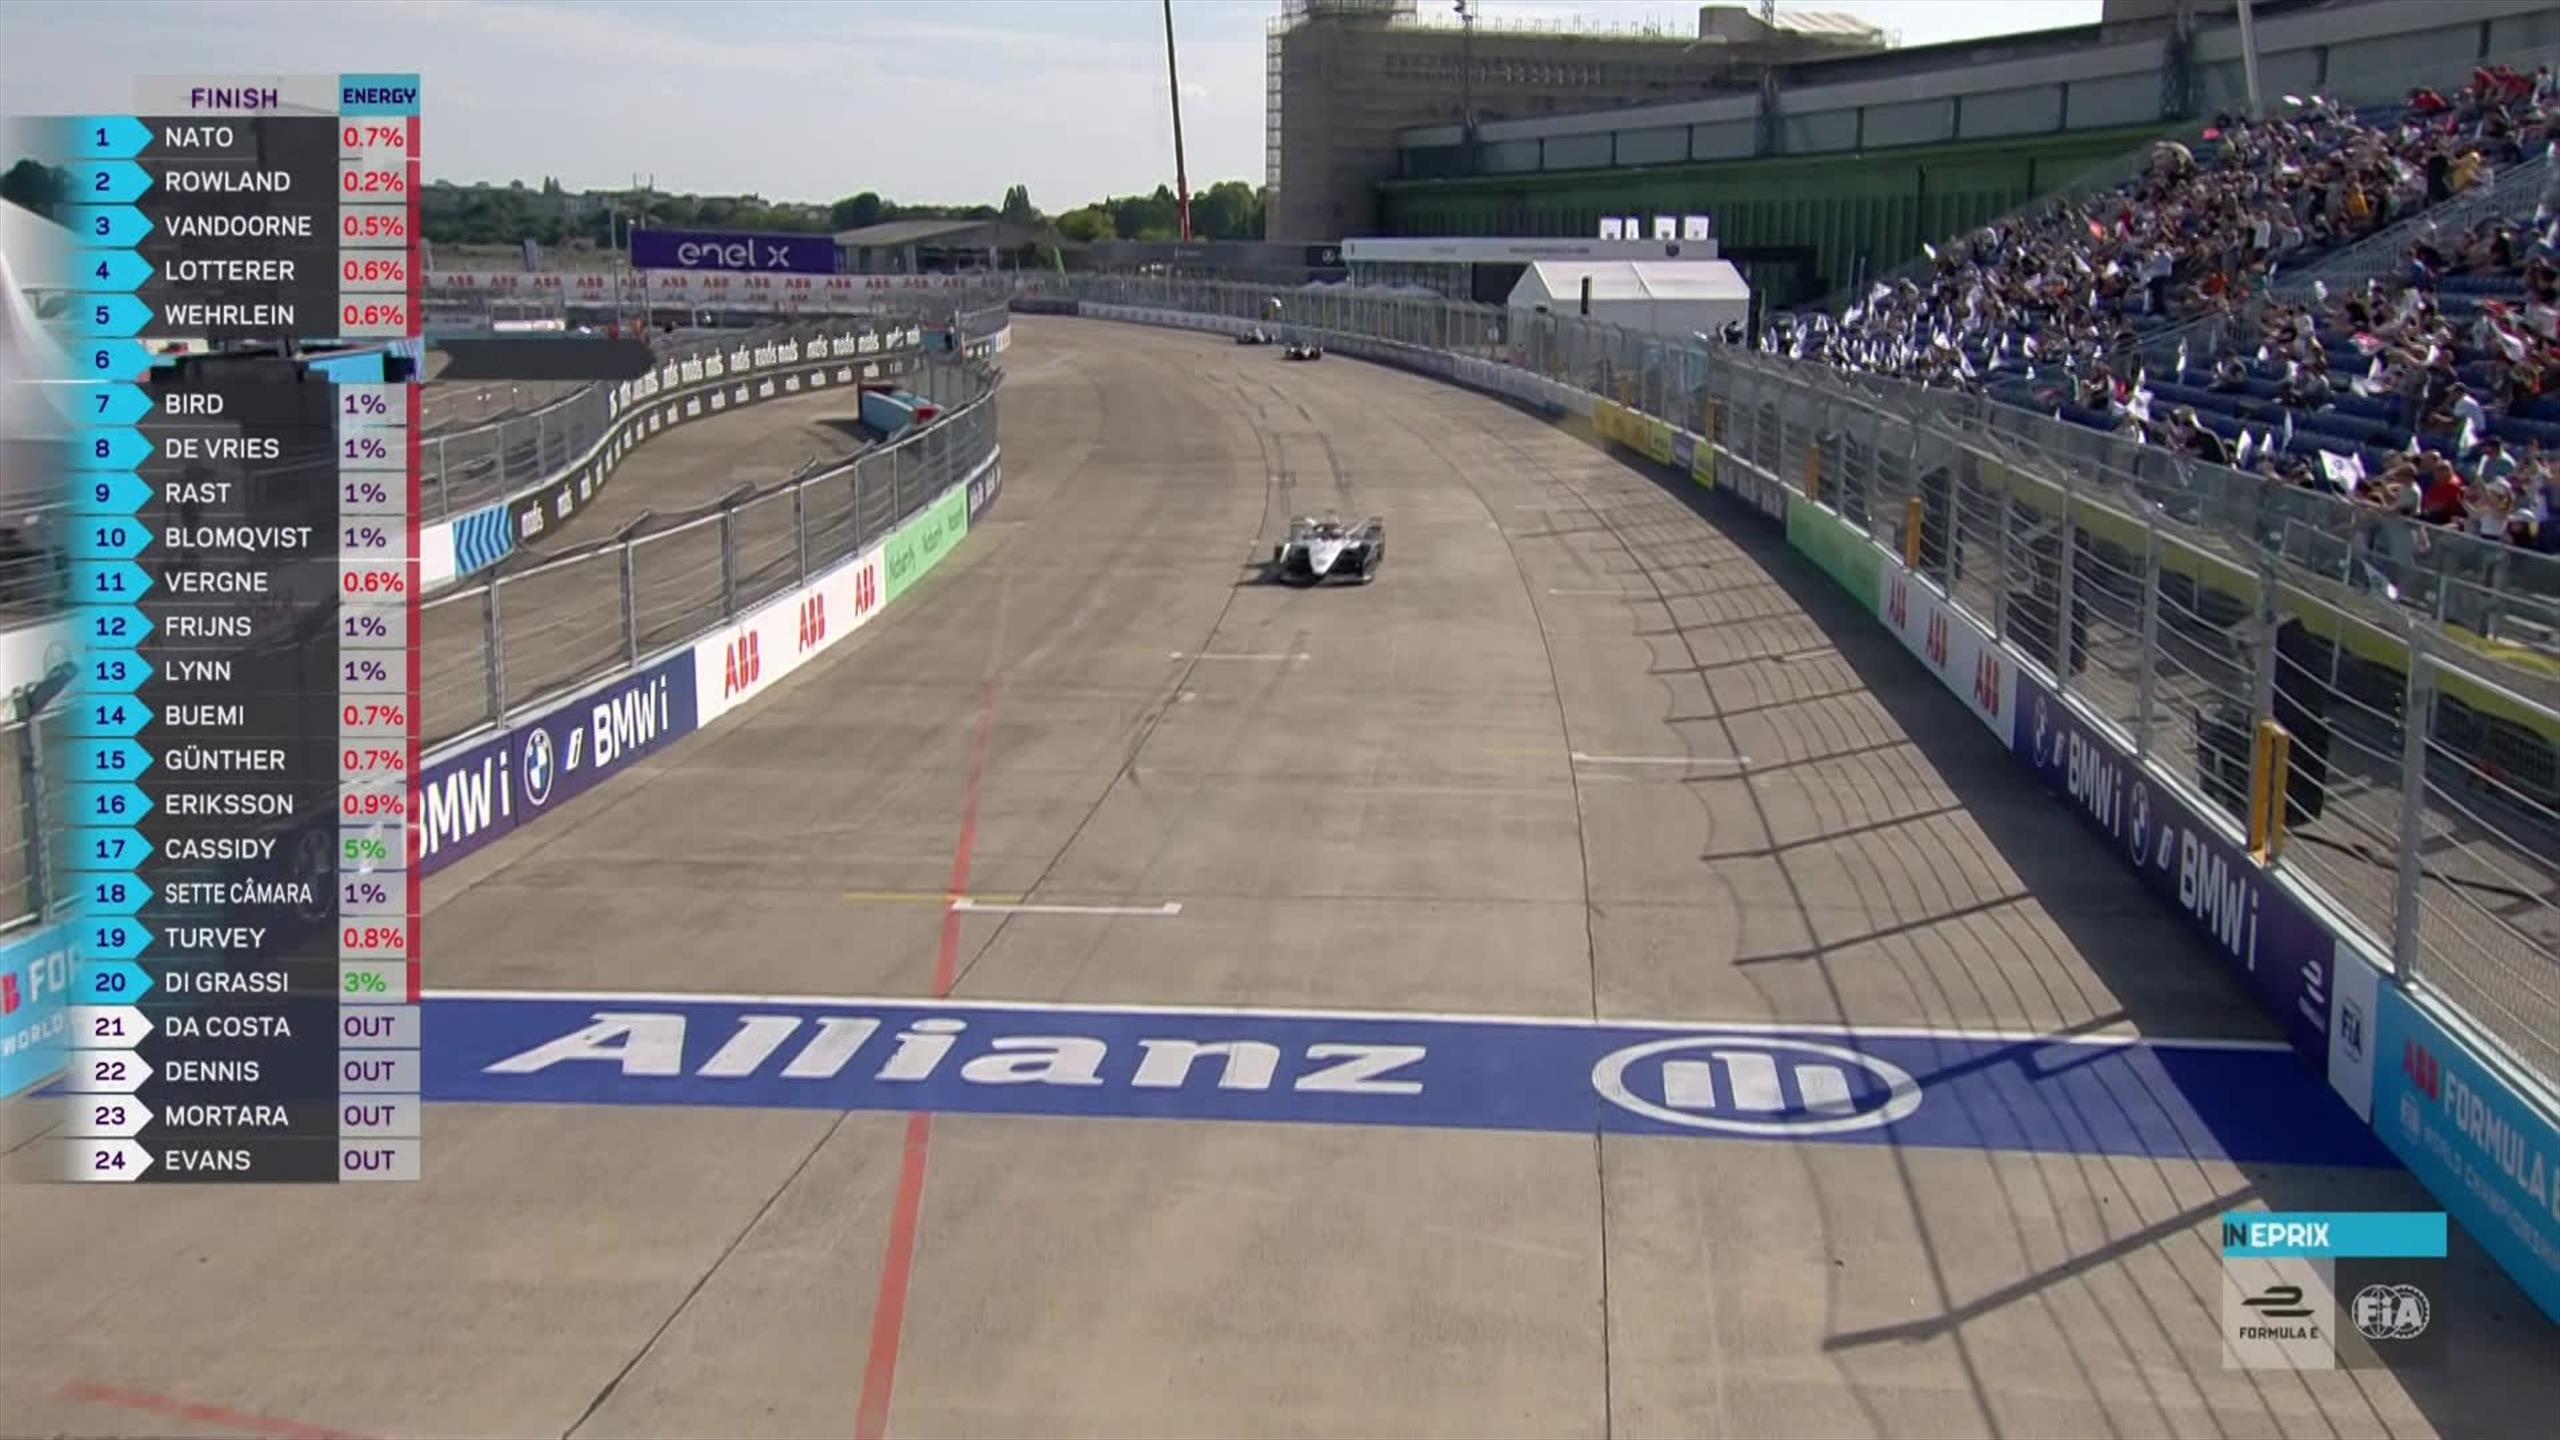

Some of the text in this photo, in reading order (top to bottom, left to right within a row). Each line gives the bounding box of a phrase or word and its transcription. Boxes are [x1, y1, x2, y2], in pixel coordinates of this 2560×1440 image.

[678, 238, 756, 266] enel
[725, 564, 876, 699] ABB ABB ABB
[1889, 575, 2000, 718] ABB ABB ABB
[592, 679, 656, 768] BMW
[2067, 731, 2113, 827] BMW
[2179, 828, 2247, 956] BMW
[481, 1012, 1427, 1094] Allianz
[2443, 1067, 2548, 1207] FORMULA
